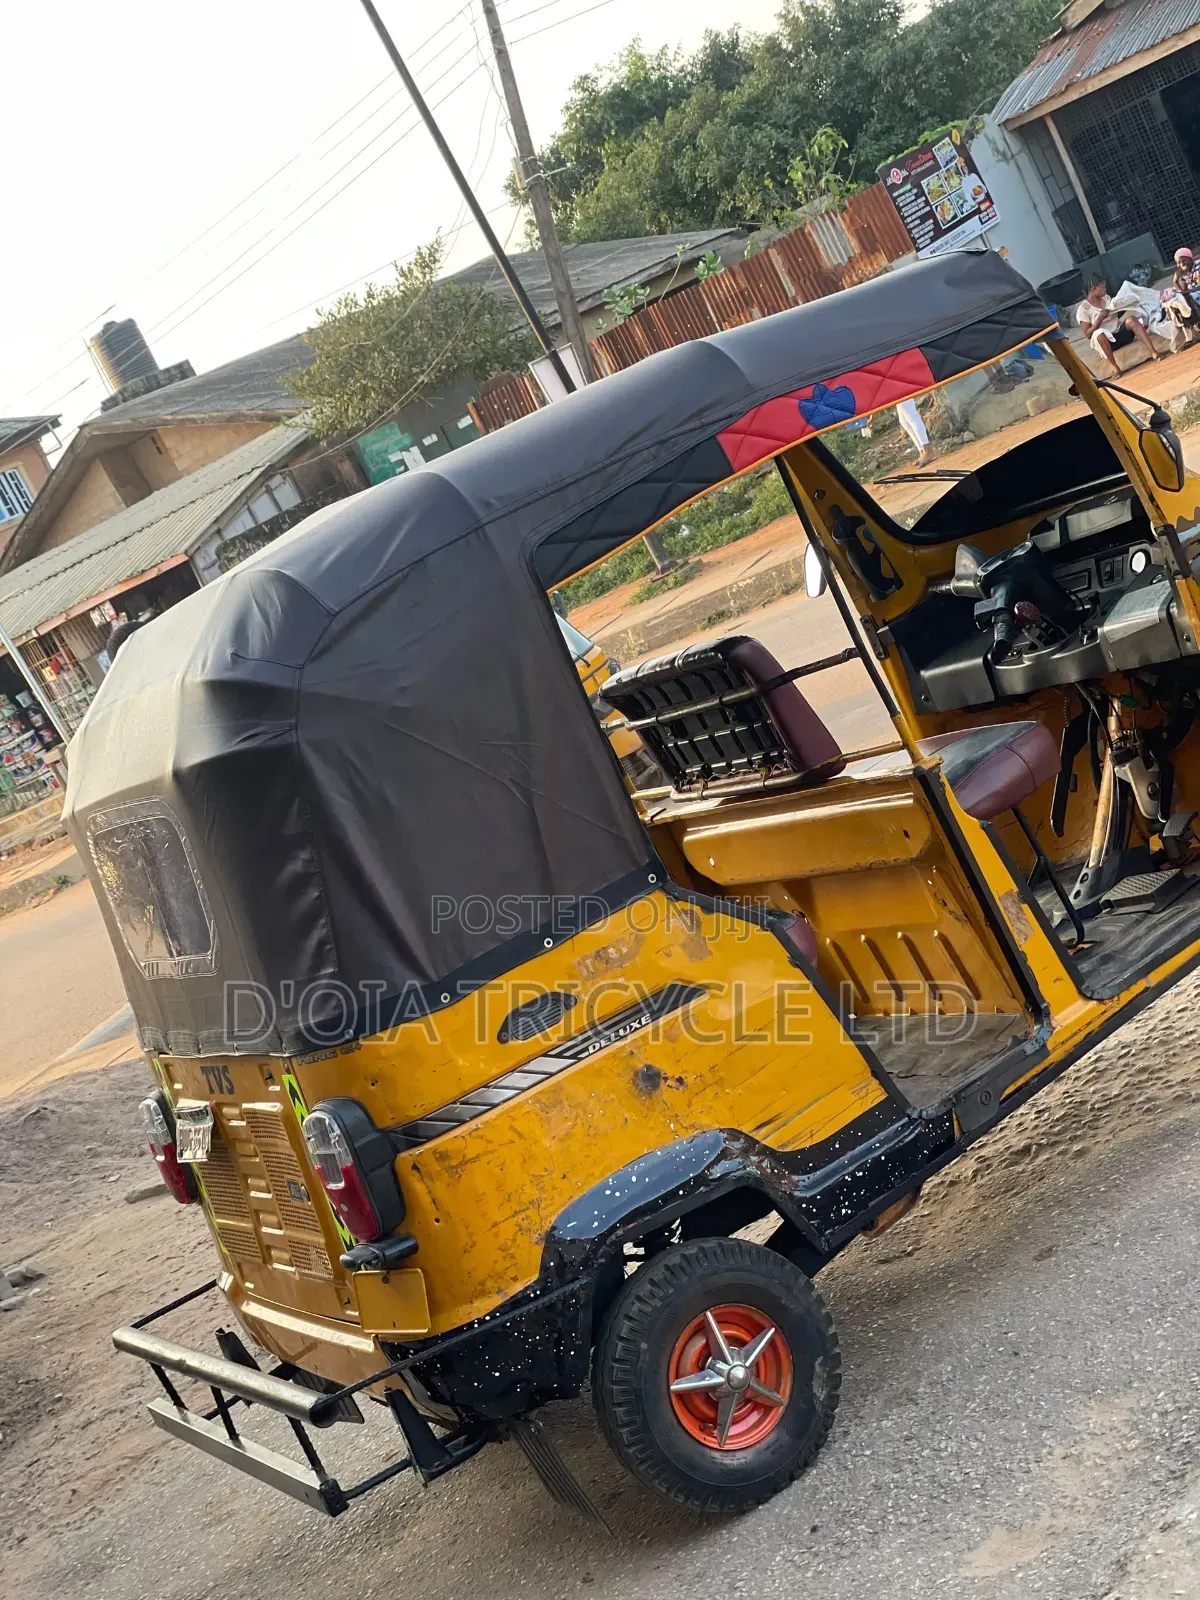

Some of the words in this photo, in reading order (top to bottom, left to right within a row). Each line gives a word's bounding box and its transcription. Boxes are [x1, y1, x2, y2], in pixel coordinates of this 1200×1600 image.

[588, 1013, 652, 1054] DELUXE
[297, 1048, 338, 1066] KING
[200, 1065, 235, 1095] TVS
